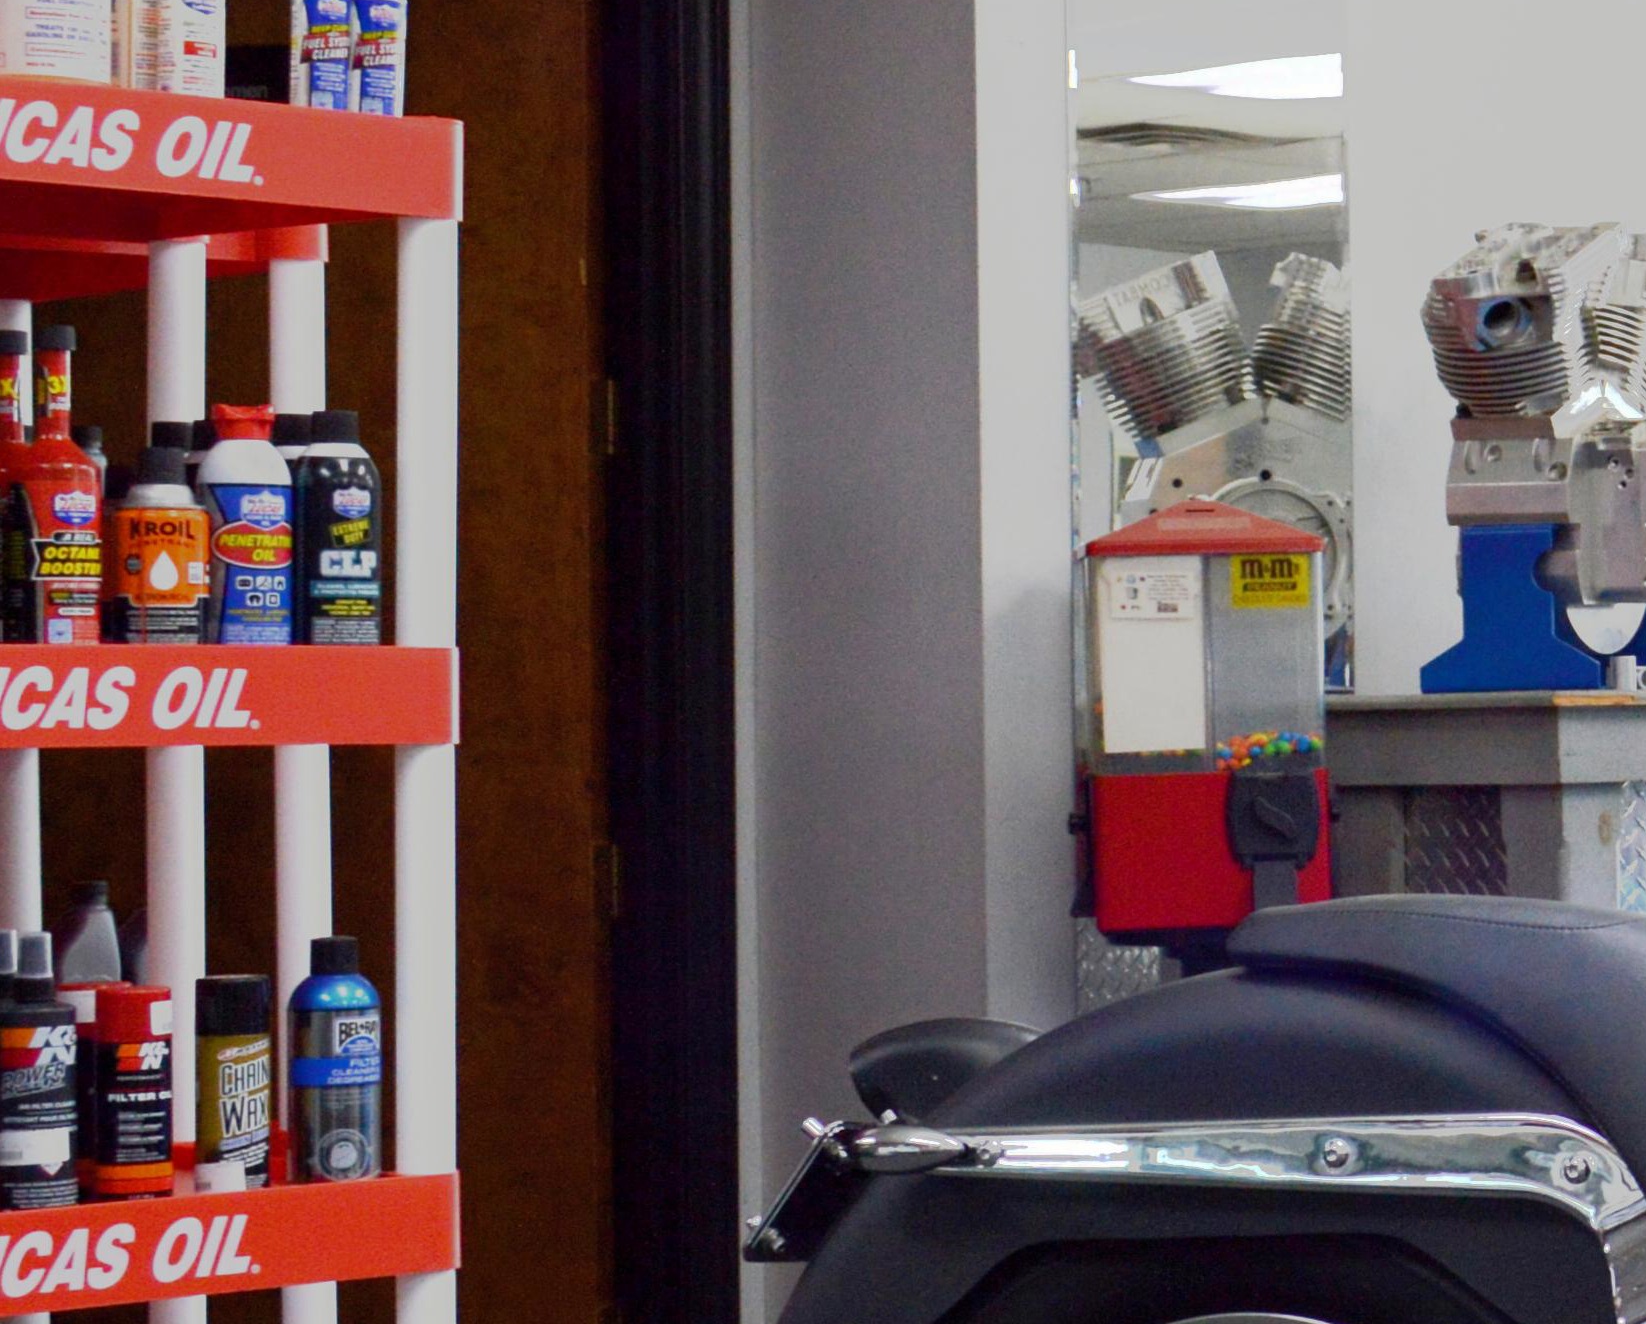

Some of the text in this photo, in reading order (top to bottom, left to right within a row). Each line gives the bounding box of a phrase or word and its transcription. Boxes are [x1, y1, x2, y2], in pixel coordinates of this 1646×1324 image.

[129, 518, 195, 541] KROIL
[252, 549, 276, 562] OIL
[320, 549, 377, 578] CLP
[221, 1058, 270, 1096] CHAIN
[107, 1092, 156, 1102] FILTER
[221, 1094, 268, 1135] WAX
